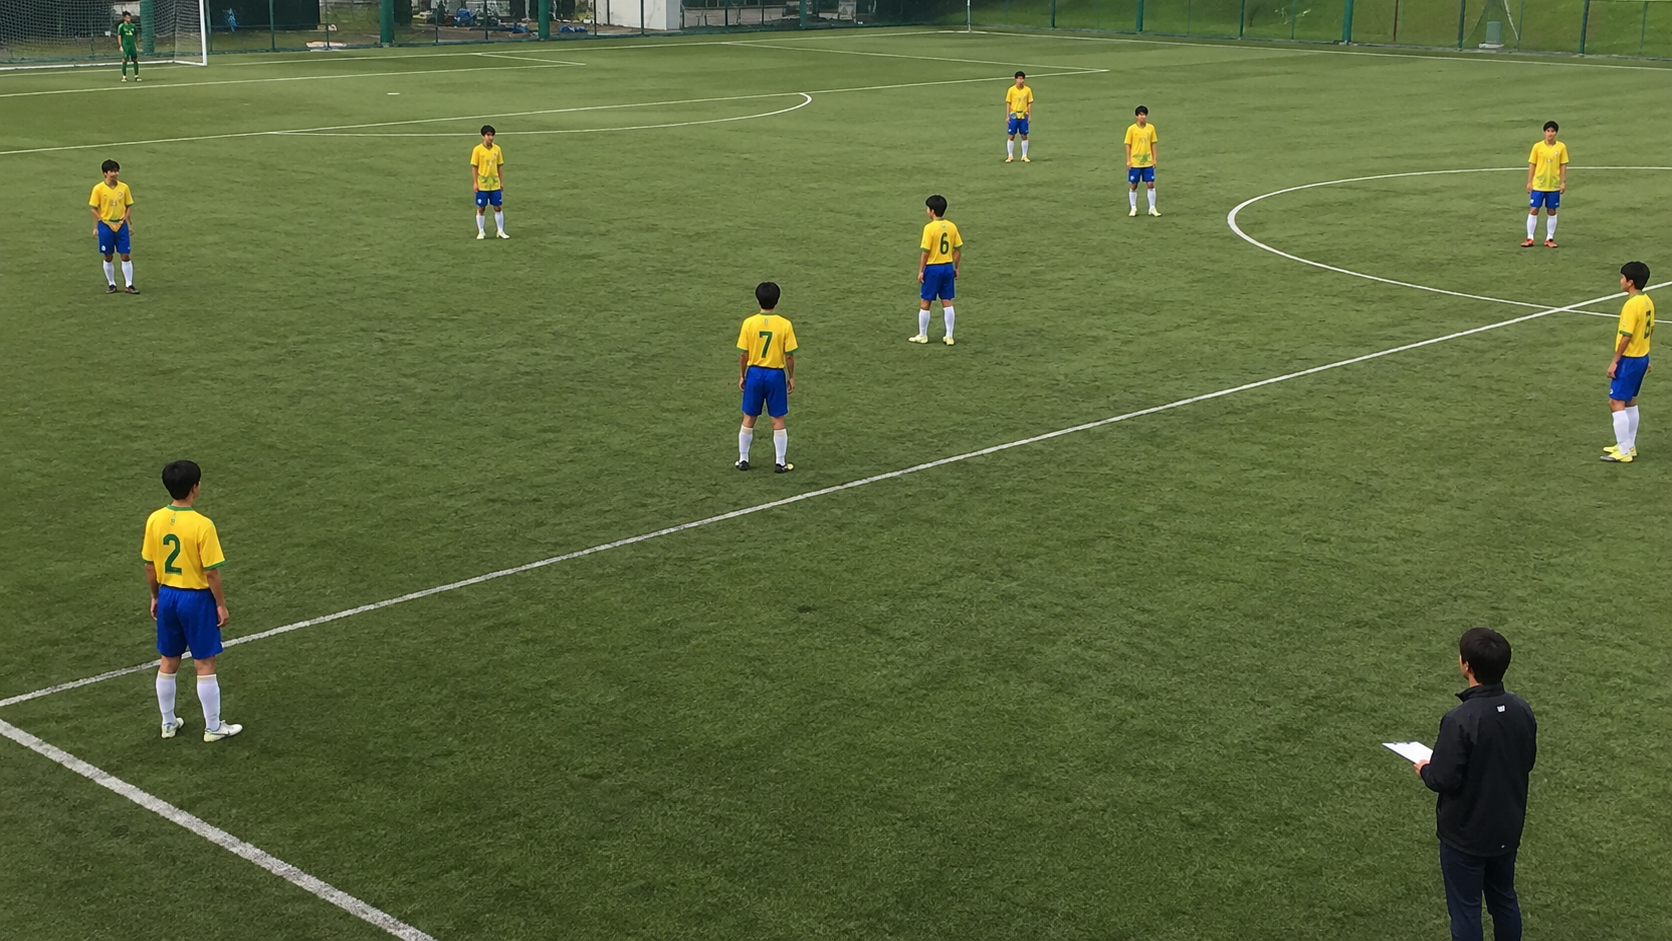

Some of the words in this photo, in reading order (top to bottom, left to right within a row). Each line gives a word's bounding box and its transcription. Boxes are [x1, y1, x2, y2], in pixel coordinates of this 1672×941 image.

[940, 232, 950, 255] 6
[759, 331, 773, 359] 7
[163, 533, 182, 575] 2
